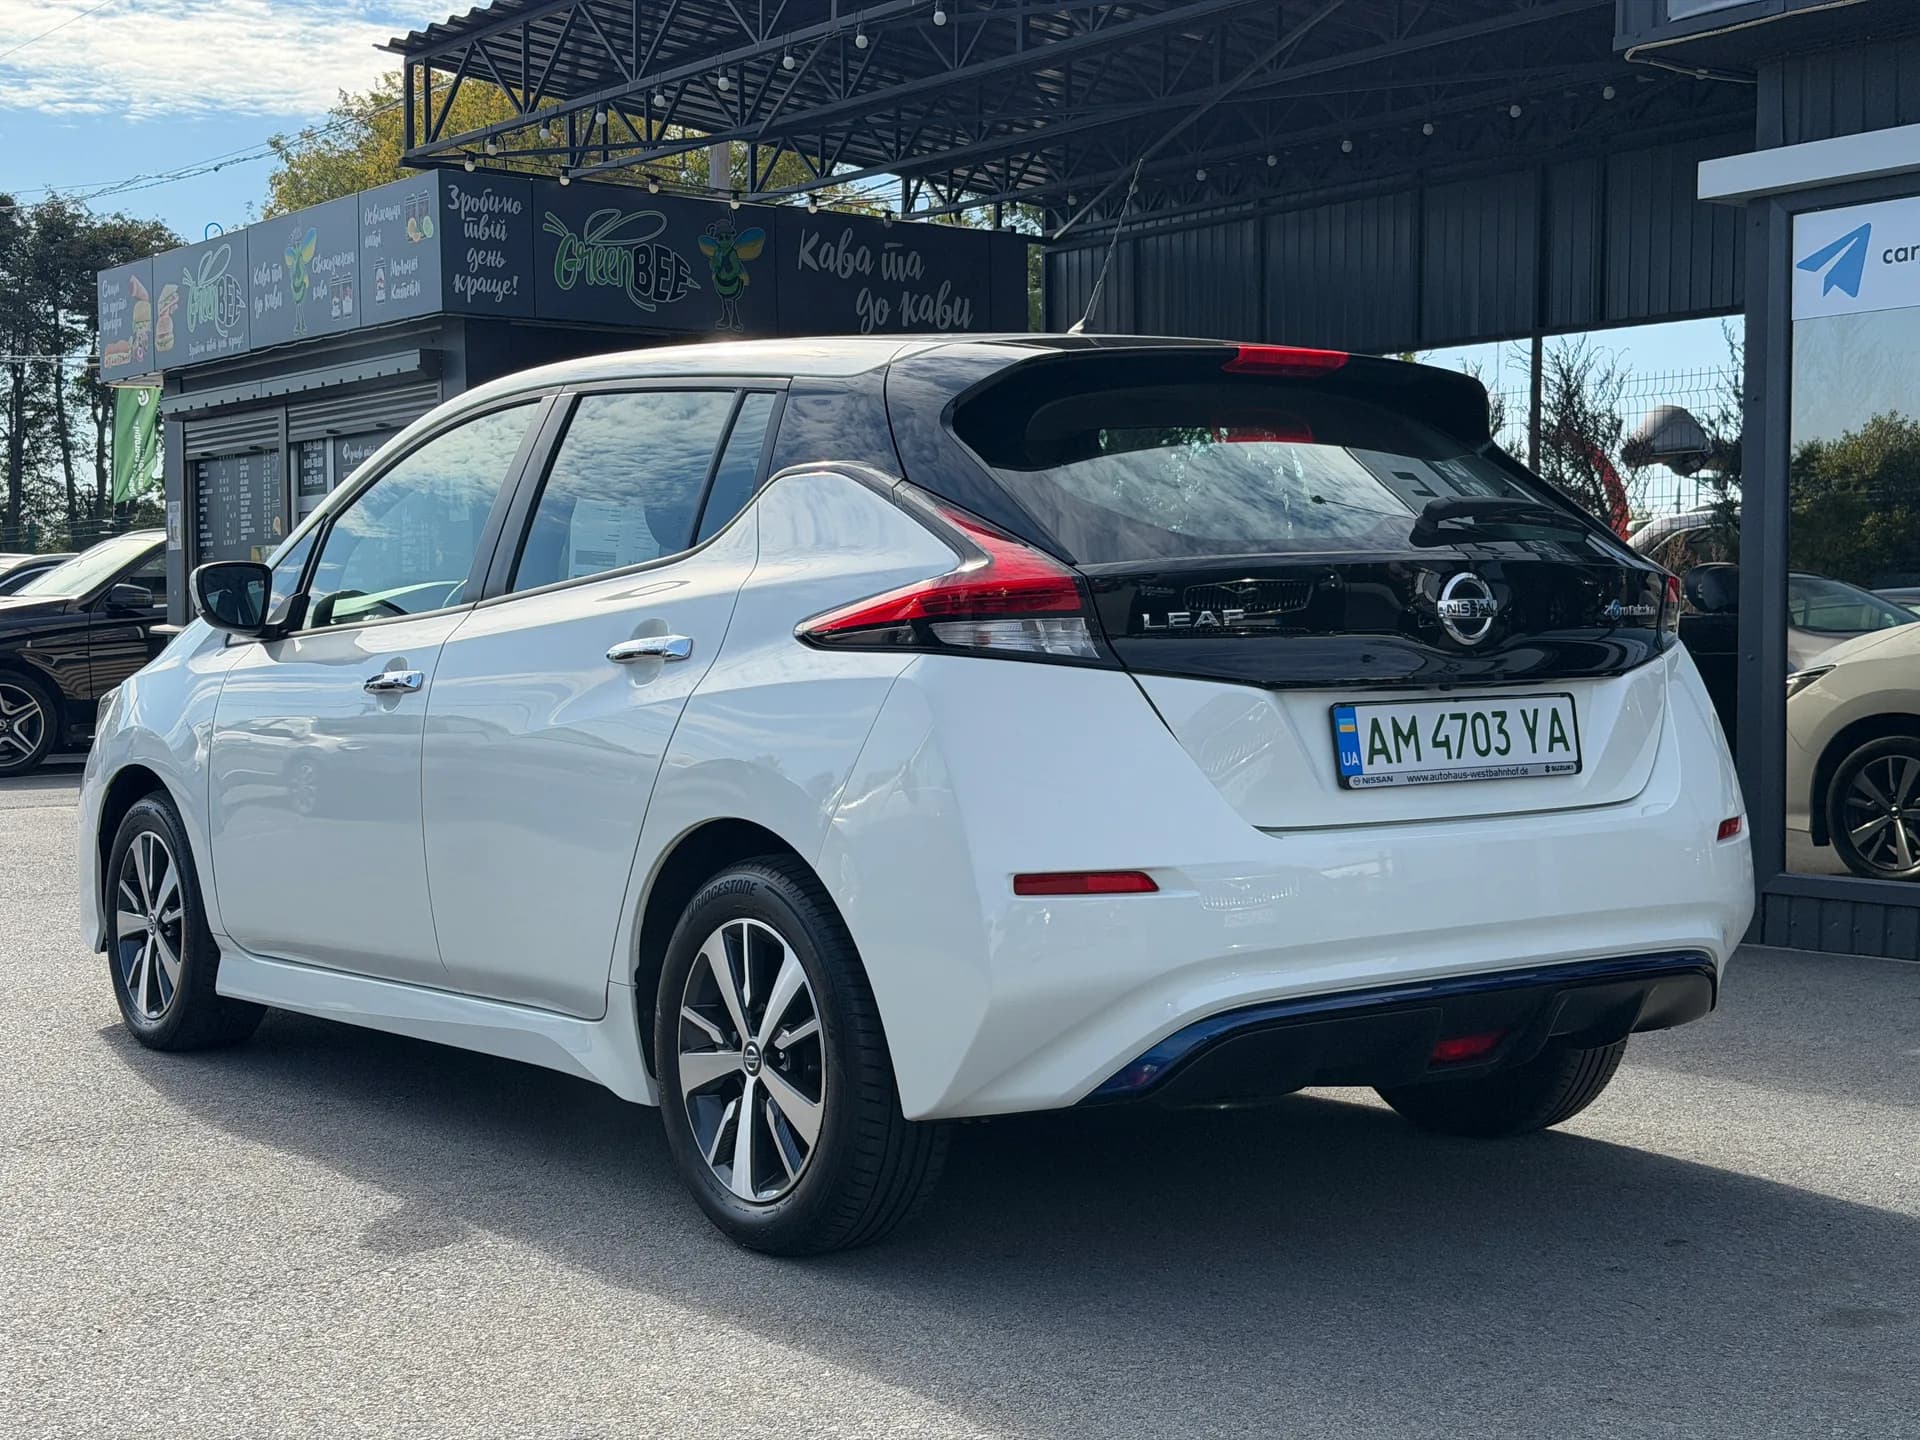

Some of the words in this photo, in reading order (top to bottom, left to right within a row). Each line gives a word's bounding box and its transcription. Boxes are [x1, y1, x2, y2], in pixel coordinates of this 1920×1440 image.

[447, 184, 523, 220] Зробимо
[463, 215, 508, 242] твій
[466, 248, 507, 273] день
[798, 227, 875, 280] Кава
[880, 241, 926, 282] та
[453, 273, 519, 303] краще!
[855, 287, 890, 335] до
[898, 279, 974, 330] кави
[1142, 608, 1245, 631] LEAF
[1446, 603, 1494, 617] NISSAN
[1367, 714, 1422, 766] AM
[1431, 710, 1511, 760] 4703
[1519, 707, 1571, 754] YA
[1342, 752, 1360, 767] UA
[1361, 775, 1394, 785] NISSAN
[1406, 766, 1529, 783] www.autohaus-westbahnhof.de
[687, 878, 760, 917] BRIDGESTONE
